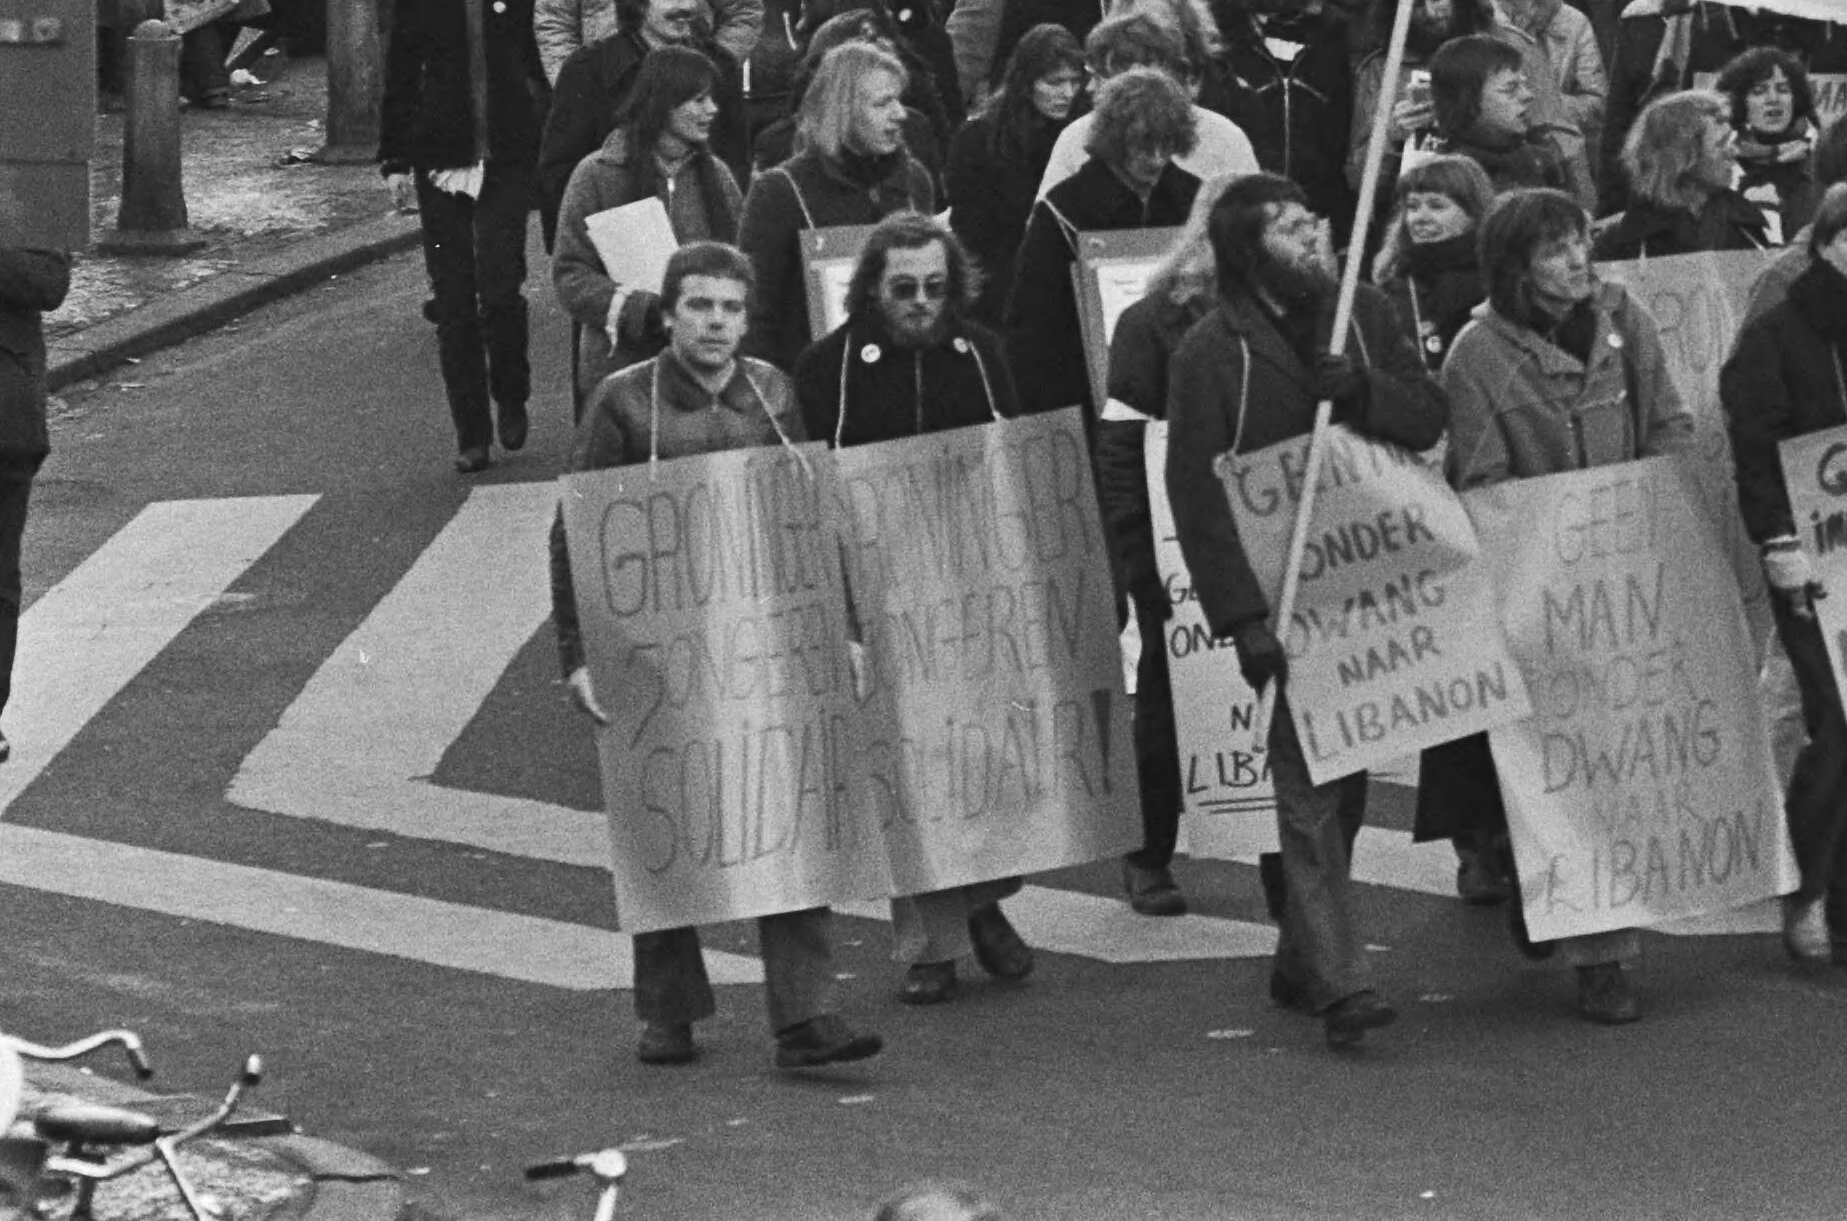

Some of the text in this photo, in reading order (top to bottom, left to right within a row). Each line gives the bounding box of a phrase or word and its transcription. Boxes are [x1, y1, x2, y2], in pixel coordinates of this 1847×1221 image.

[1300, 505, 1437, 581] ONDER
[1287, 567, 1447, 660] DWANG
[1337, 624, 1442, 688] NAAR
[1541, 562, 1666, 657] MAN
[1303, 661, 1508, 763] LIBANON
[1541, 697, 1722, 795] DWANG
[1544, 801, 1766, 917] LIBANON
